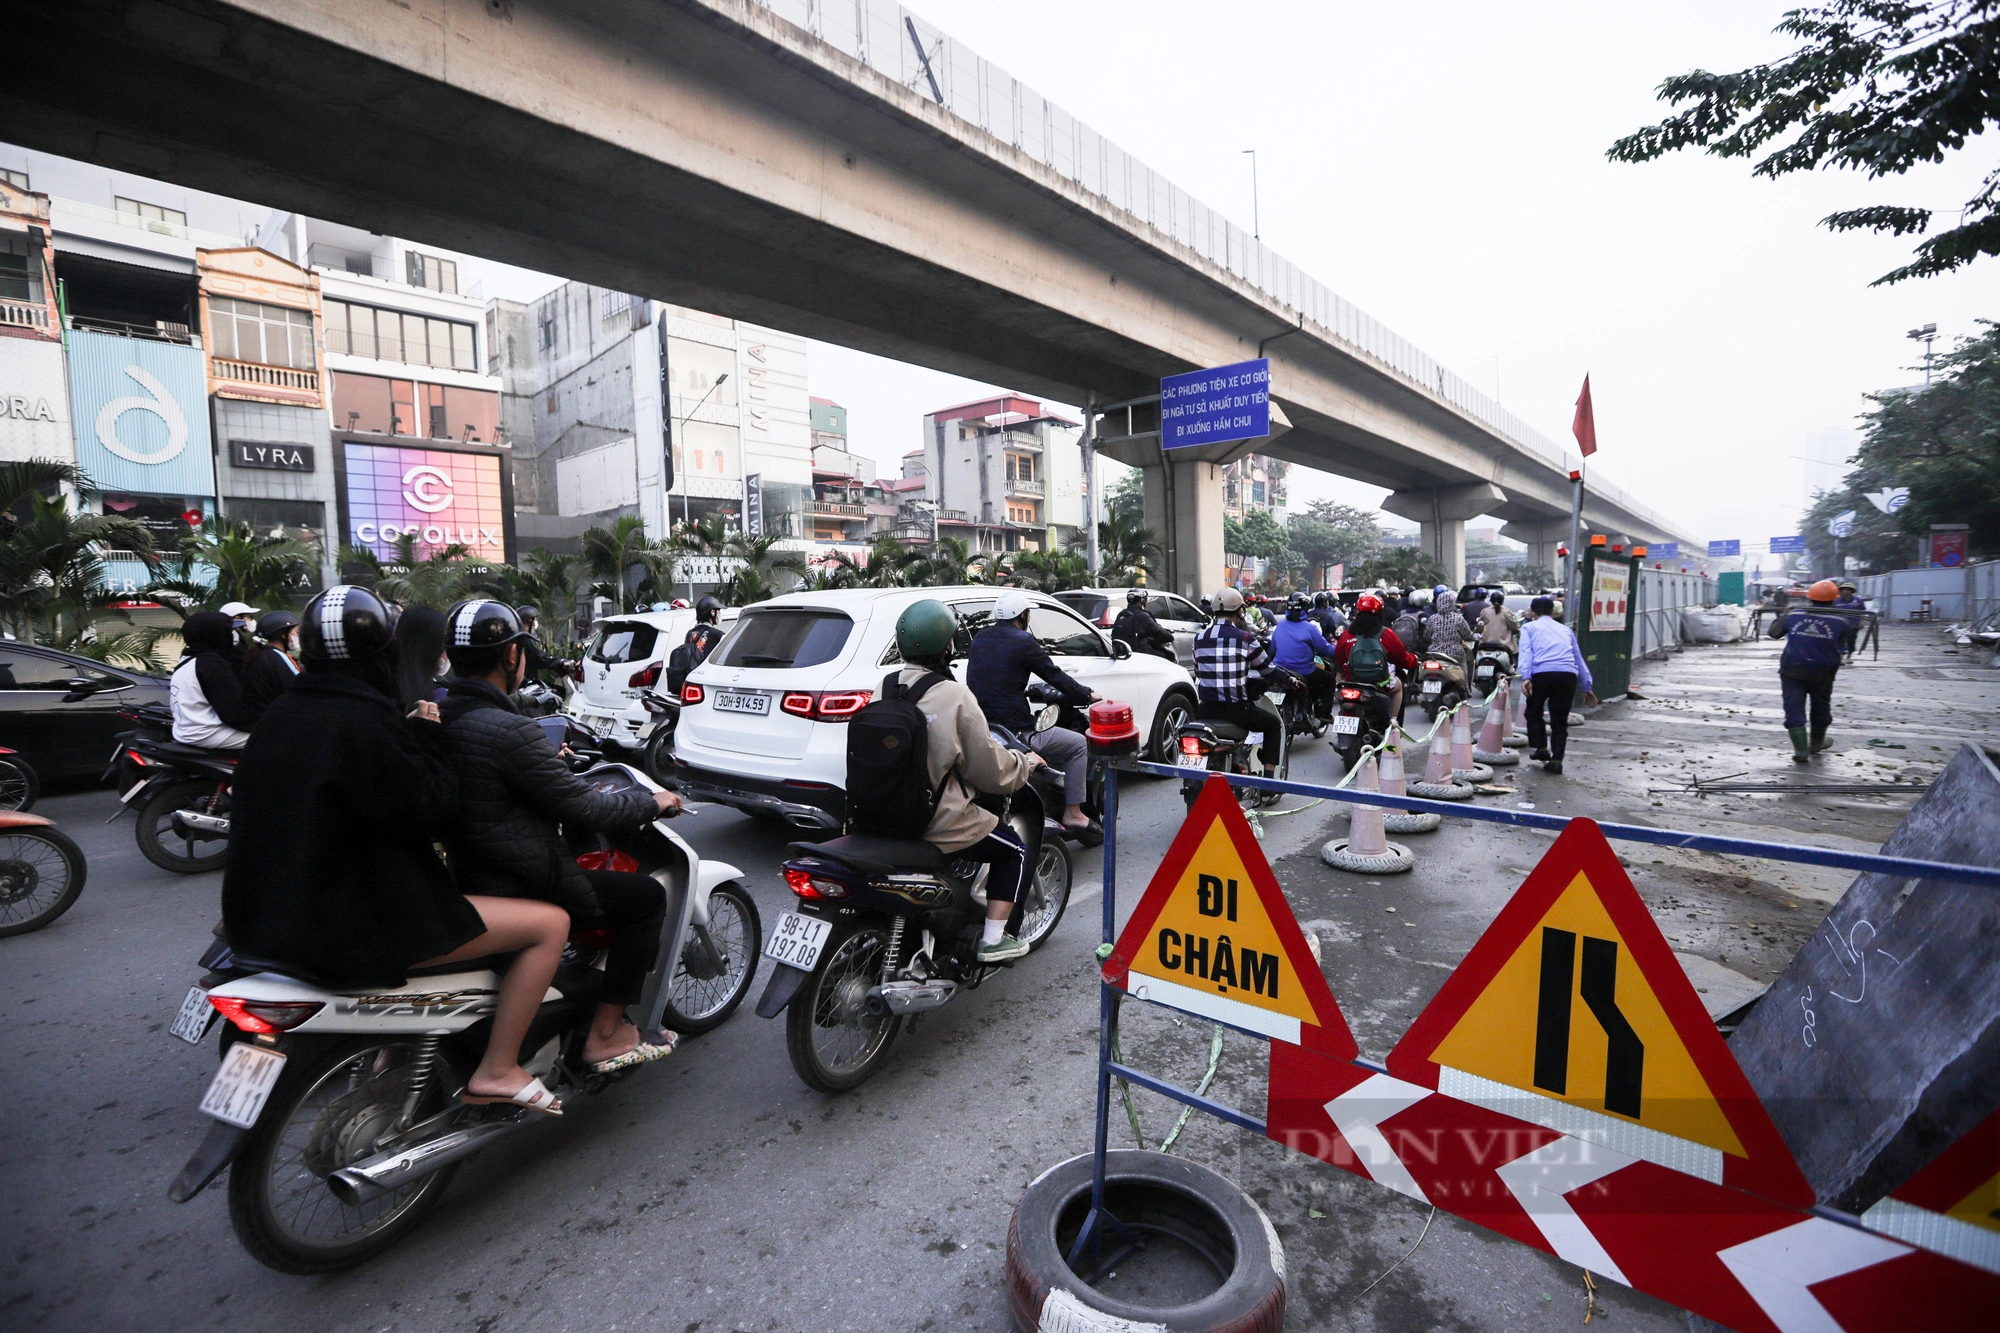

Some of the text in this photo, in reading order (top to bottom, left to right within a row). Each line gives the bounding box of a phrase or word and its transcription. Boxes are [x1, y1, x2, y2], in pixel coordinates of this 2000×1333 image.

[748, 344, 768, 431] MINA
[1162, 368, 1267, 400] CÁC PHƯƠNG TIỆN XE CƠ GIỚI
[1162, 409, 1169, 419] ĐI
[1171, 404, 1184, 418] NGÃ
[1185, 404, 1195, 415] TƯ
[1209, 394, 1232, 411] KHUẤT
[1234, 395, 1249, 407] DUY
[1251, 388, 1267, 404] TIẾN
[1177, 415, 1251, 436] ĐI XUỐNG HẦM CHUI
[243, 446, 304, 465] LYRA
[749, 476, 759, 535] MINA
[718, 695, 764, 711] 30H-914.59
[1180, 756, 1203, 766] 29-X7
[1197, 873, 1238, 922] ĐI
[782, 915, 822, 943] 98-L1
[770, 936, 817, 967] 197.08
[1158, 928, 1279, 999] CHẬM
